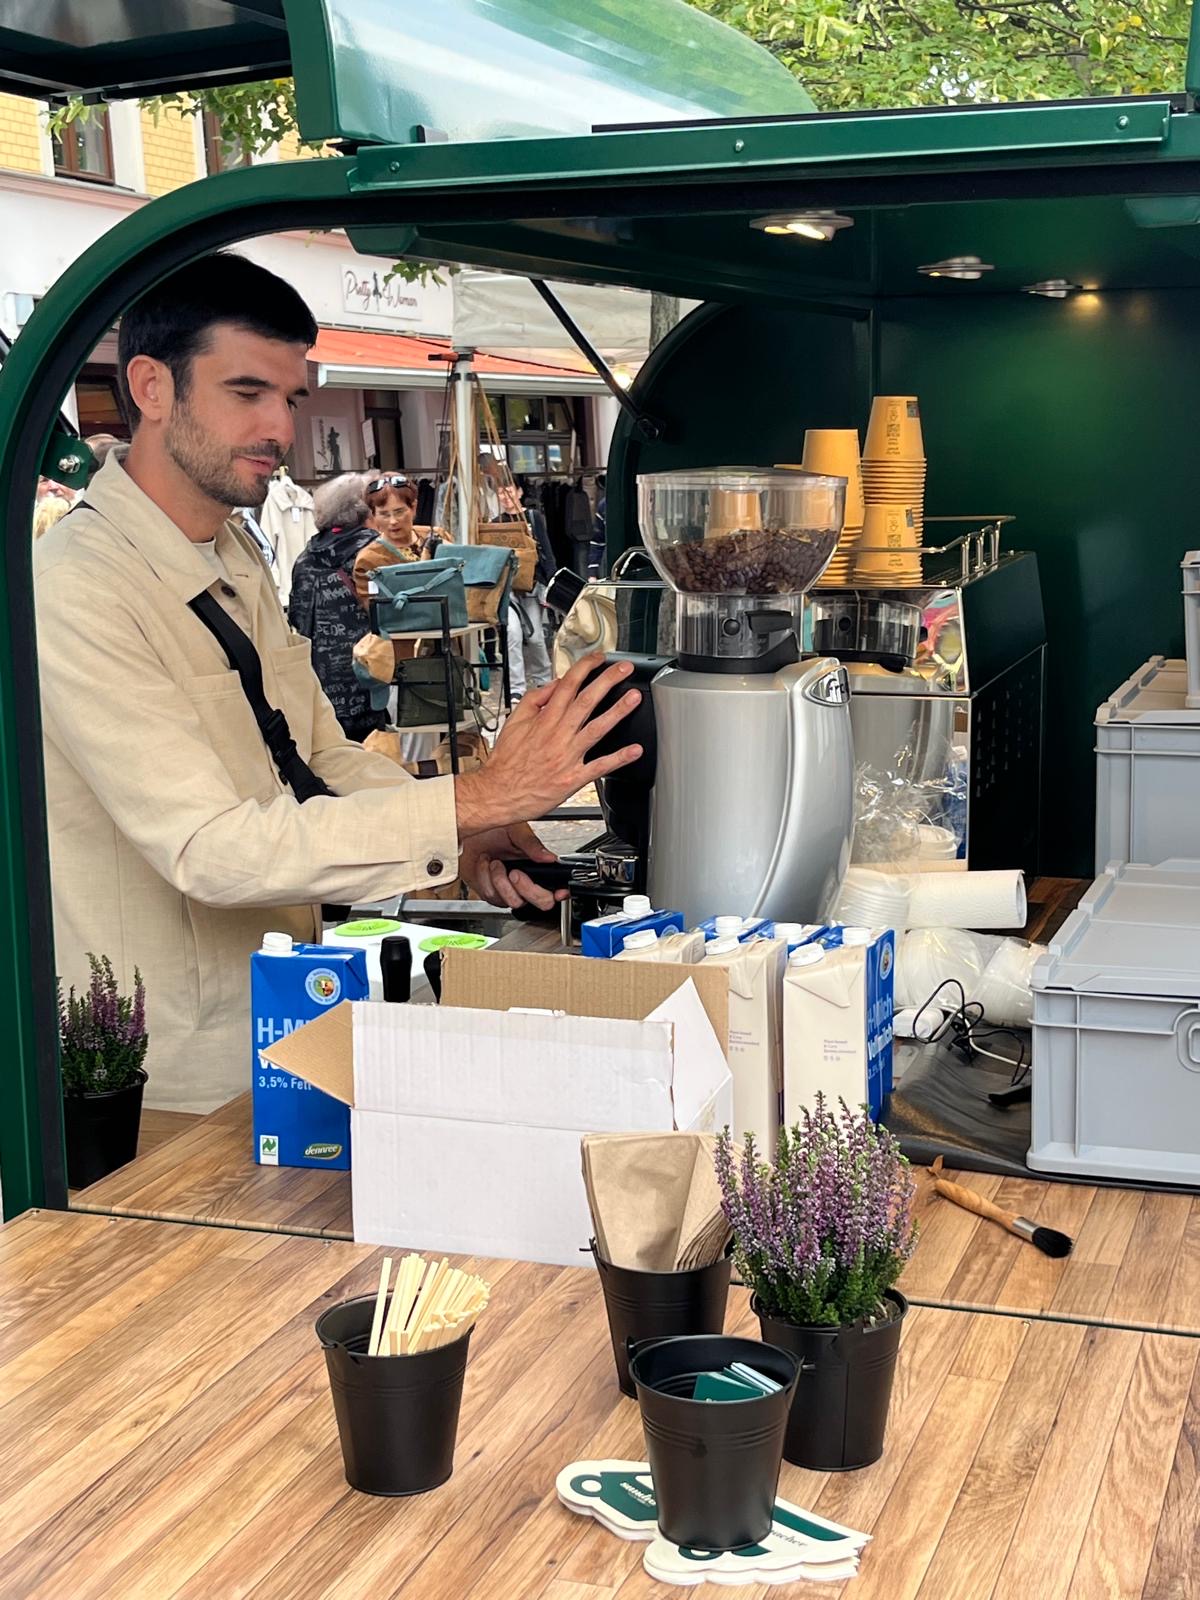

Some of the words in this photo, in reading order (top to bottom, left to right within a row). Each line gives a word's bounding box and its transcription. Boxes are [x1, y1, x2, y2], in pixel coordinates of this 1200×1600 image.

[345, 271, 371, 311] Pretty
[382, 284, 417, 308] Woman
[259, 1075, 288, 1089] 3,5%
[305, 1143, 339, 1155] dennree
